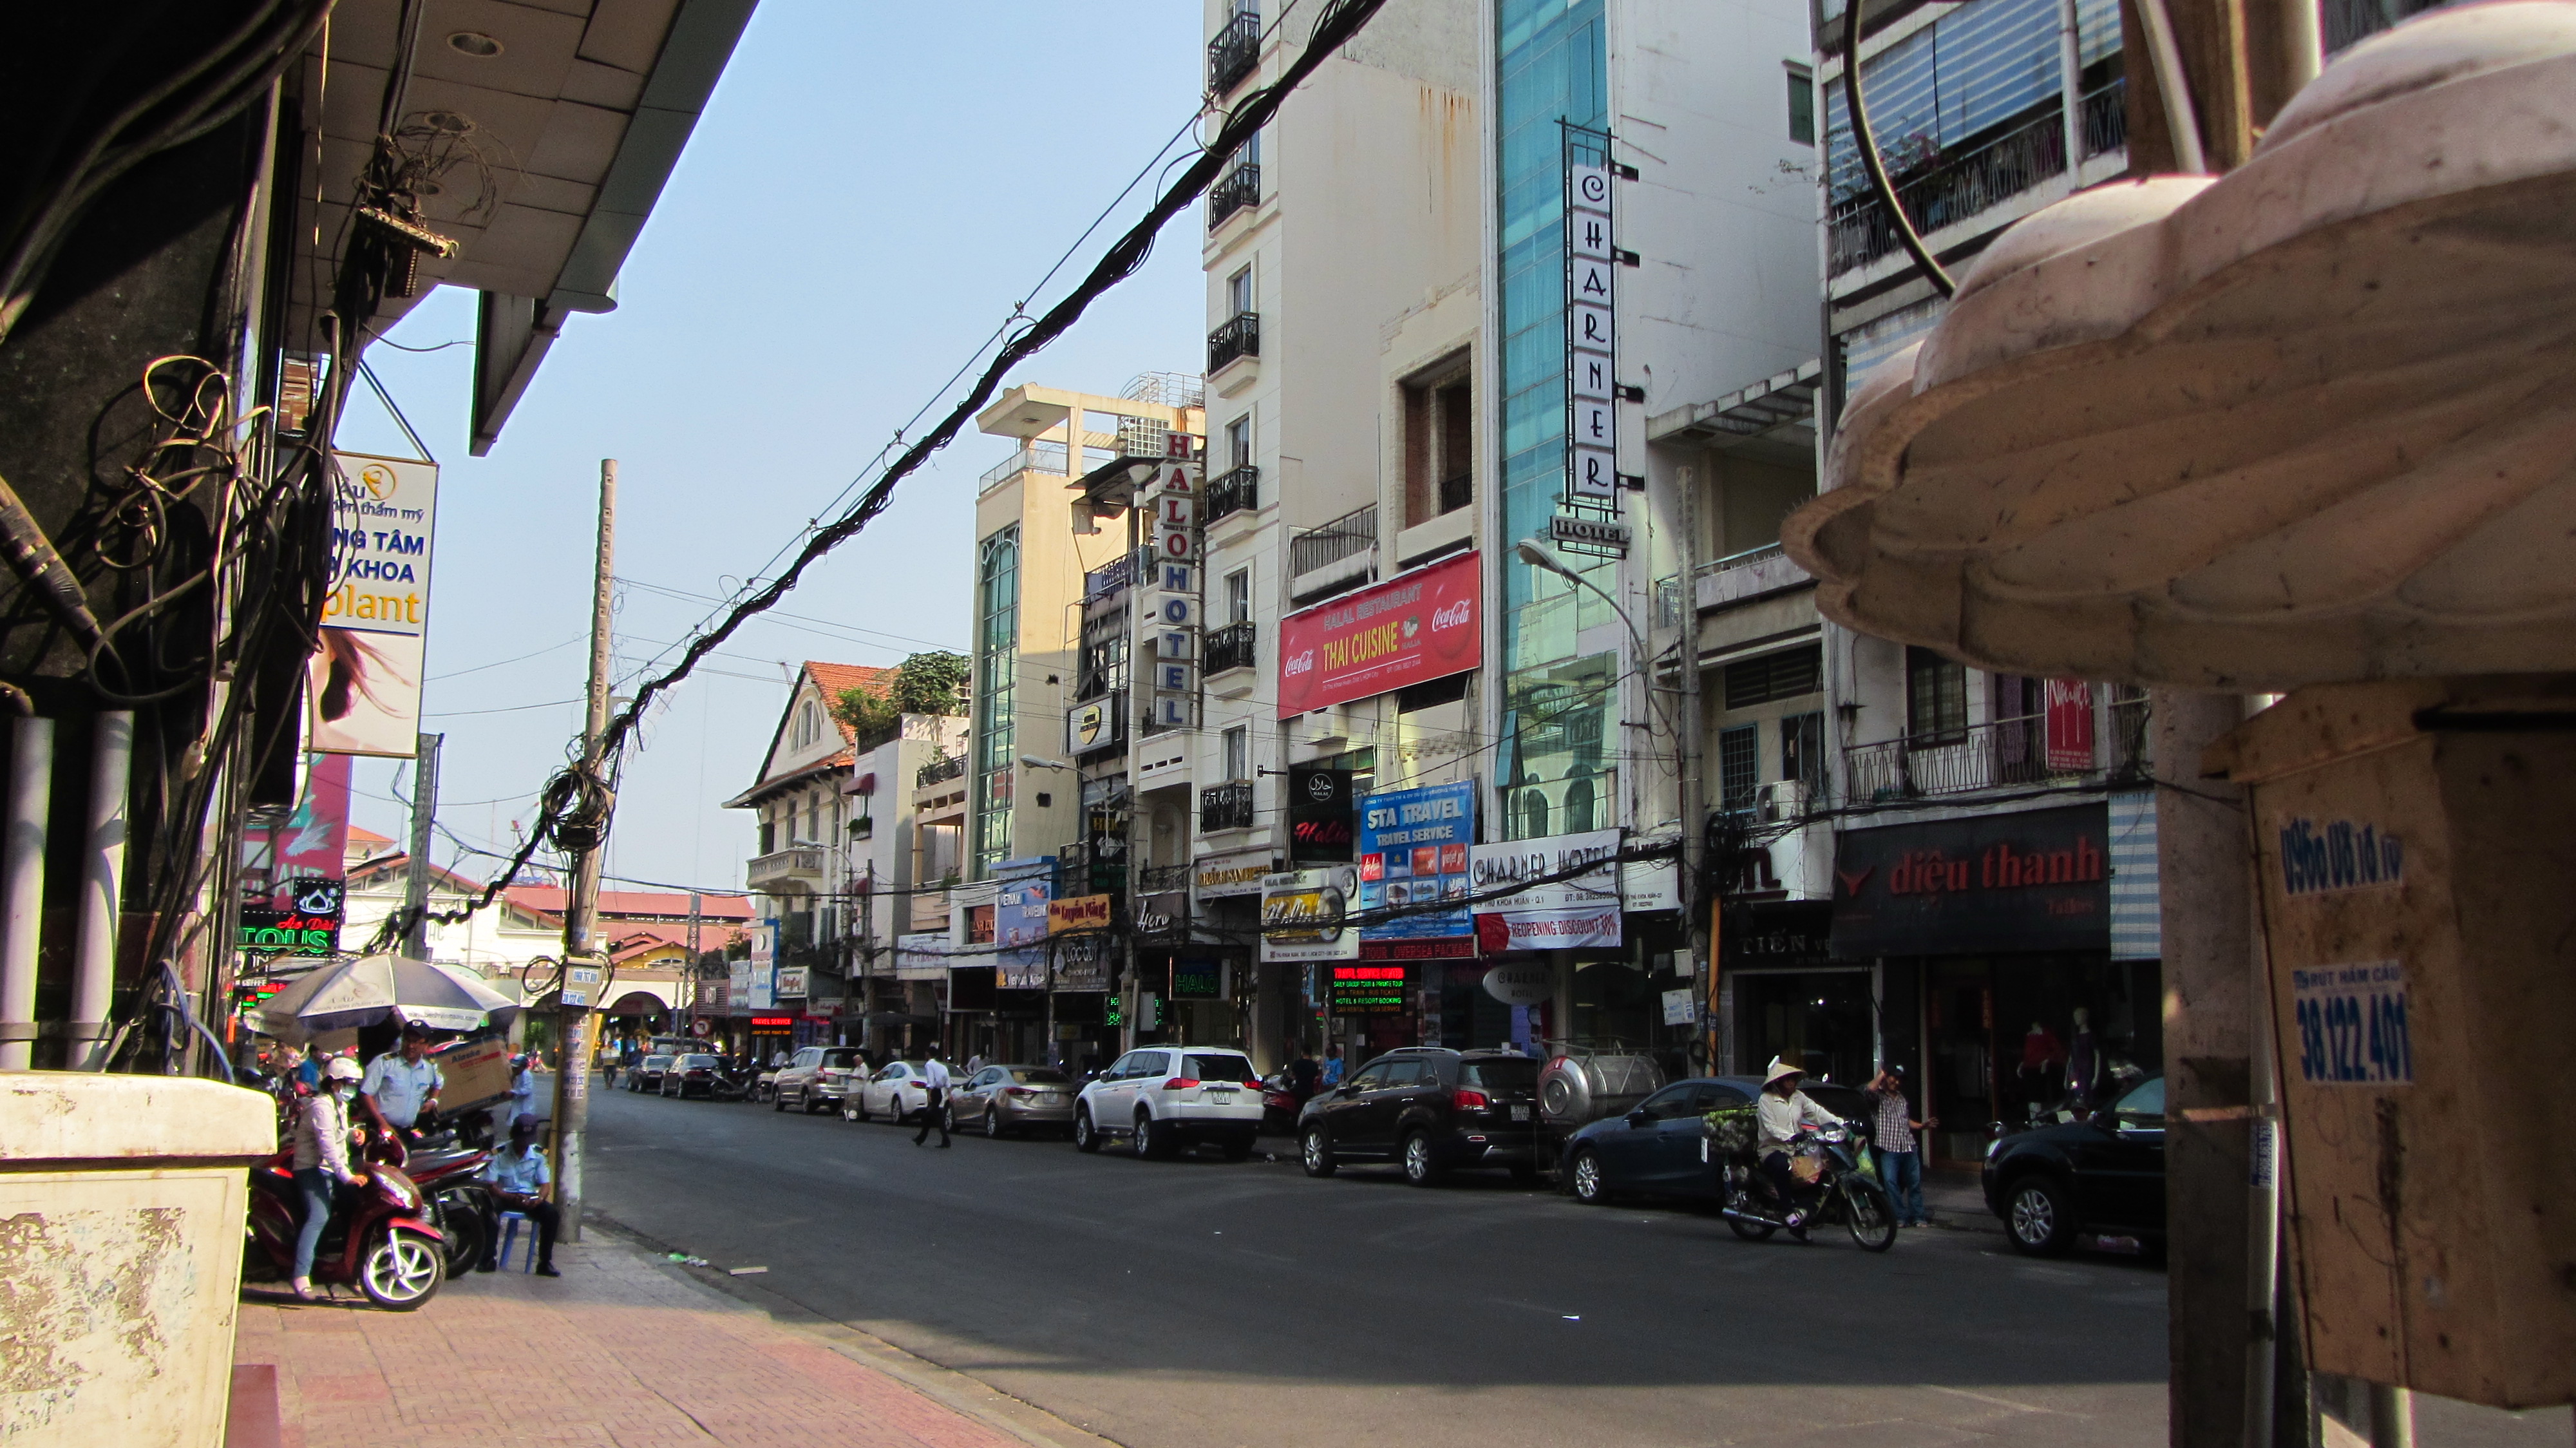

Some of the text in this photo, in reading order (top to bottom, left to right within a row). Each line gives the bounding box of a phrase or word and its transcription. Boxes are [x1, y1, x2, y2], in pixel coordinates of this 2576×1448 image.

[1582, 175, 1607, 487] CHARNER
[373, 529, 424, 556] TÂM
[1559, 520, 1630, 543] HOTEL
[347, 558, 415, 584] KHOA
[1324, 583, 1423, 631] HALAL RESTAURANT
[1323, 622, 1398, 671] THAI CUISINE
[1368, 797, 1463, 830] STA TRAVEL
[1377, 825, 1454, 847] TRAVEL SERVICE
[1473, 853, 1546, 884] CHARNER
[1889, 835, 2102, 910] diệu thanh
[1513, 922, 1557, 937] REOPENING
[1558, 919, 1599, 934] DISCOUNT
[1741, 928, 1805, 954] TIẾN
[1175, 975, 1217, 993] HALO
[1334, 968, 1356, 978] TRAVEL
[1498, 972, 1547, 984] CHARNER
[2297, 993, 2412, 1081] 38.122.401
